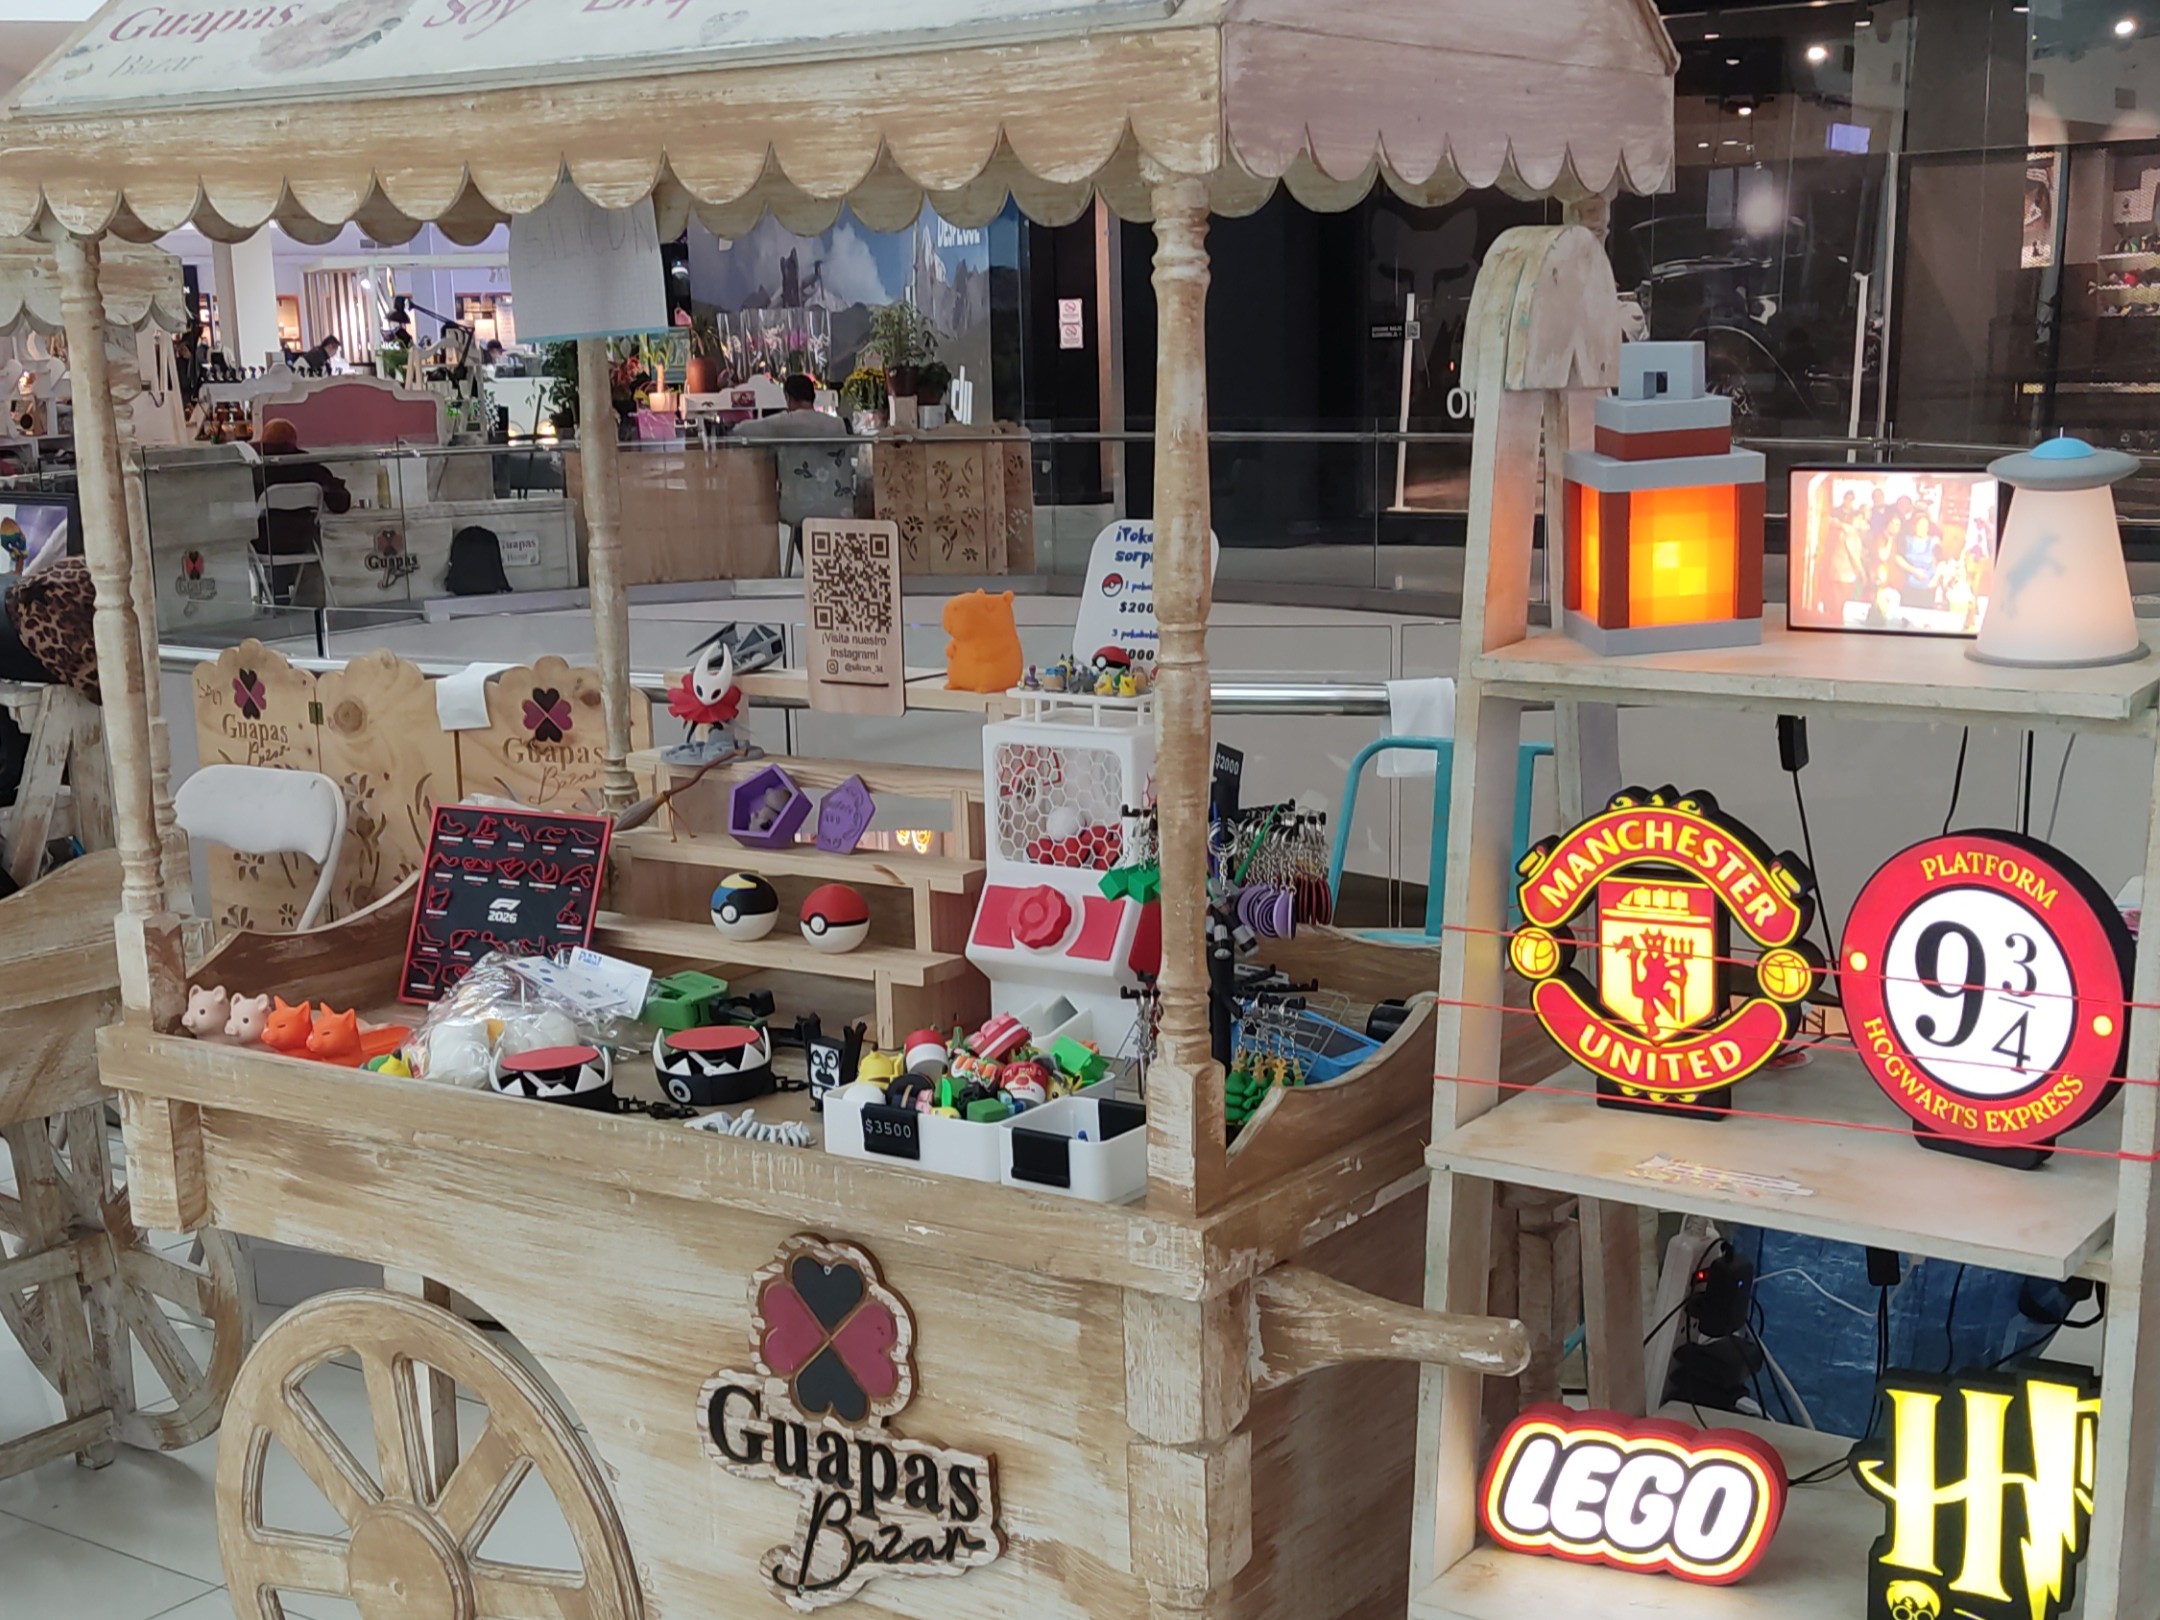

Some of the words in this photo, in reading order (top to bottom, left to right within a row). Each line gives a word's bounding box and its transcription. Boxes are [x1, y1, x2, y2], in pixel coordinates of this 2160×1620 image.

[109, 4, 302, 43] Guapas
[852, 635, 887, 647] nuestro
[222, 713, 288, 748] Guapas
[503, 737, 603, 771] Guapas
[1216, 753, 1239, 775] $2000
[1540, 820, 1777, 928] MANCHESTER
[1920, 851, 2059, 910] PLATFORM
[488, 910, 518, 924] 2026
[1578, 1024, 1742, 1082] UNITED
[1863, 1016, 1979, 1130] HOGWARTS
[865, 1118, 911, 1138] $3500
[1984, 1073, 2084, 1132] EXPRESS
[708, 1384, 980, 1522] Guapas
[1503, 1438, 1753, 1560] LEGO
[772, 1491, 986, 1598] Bazar
